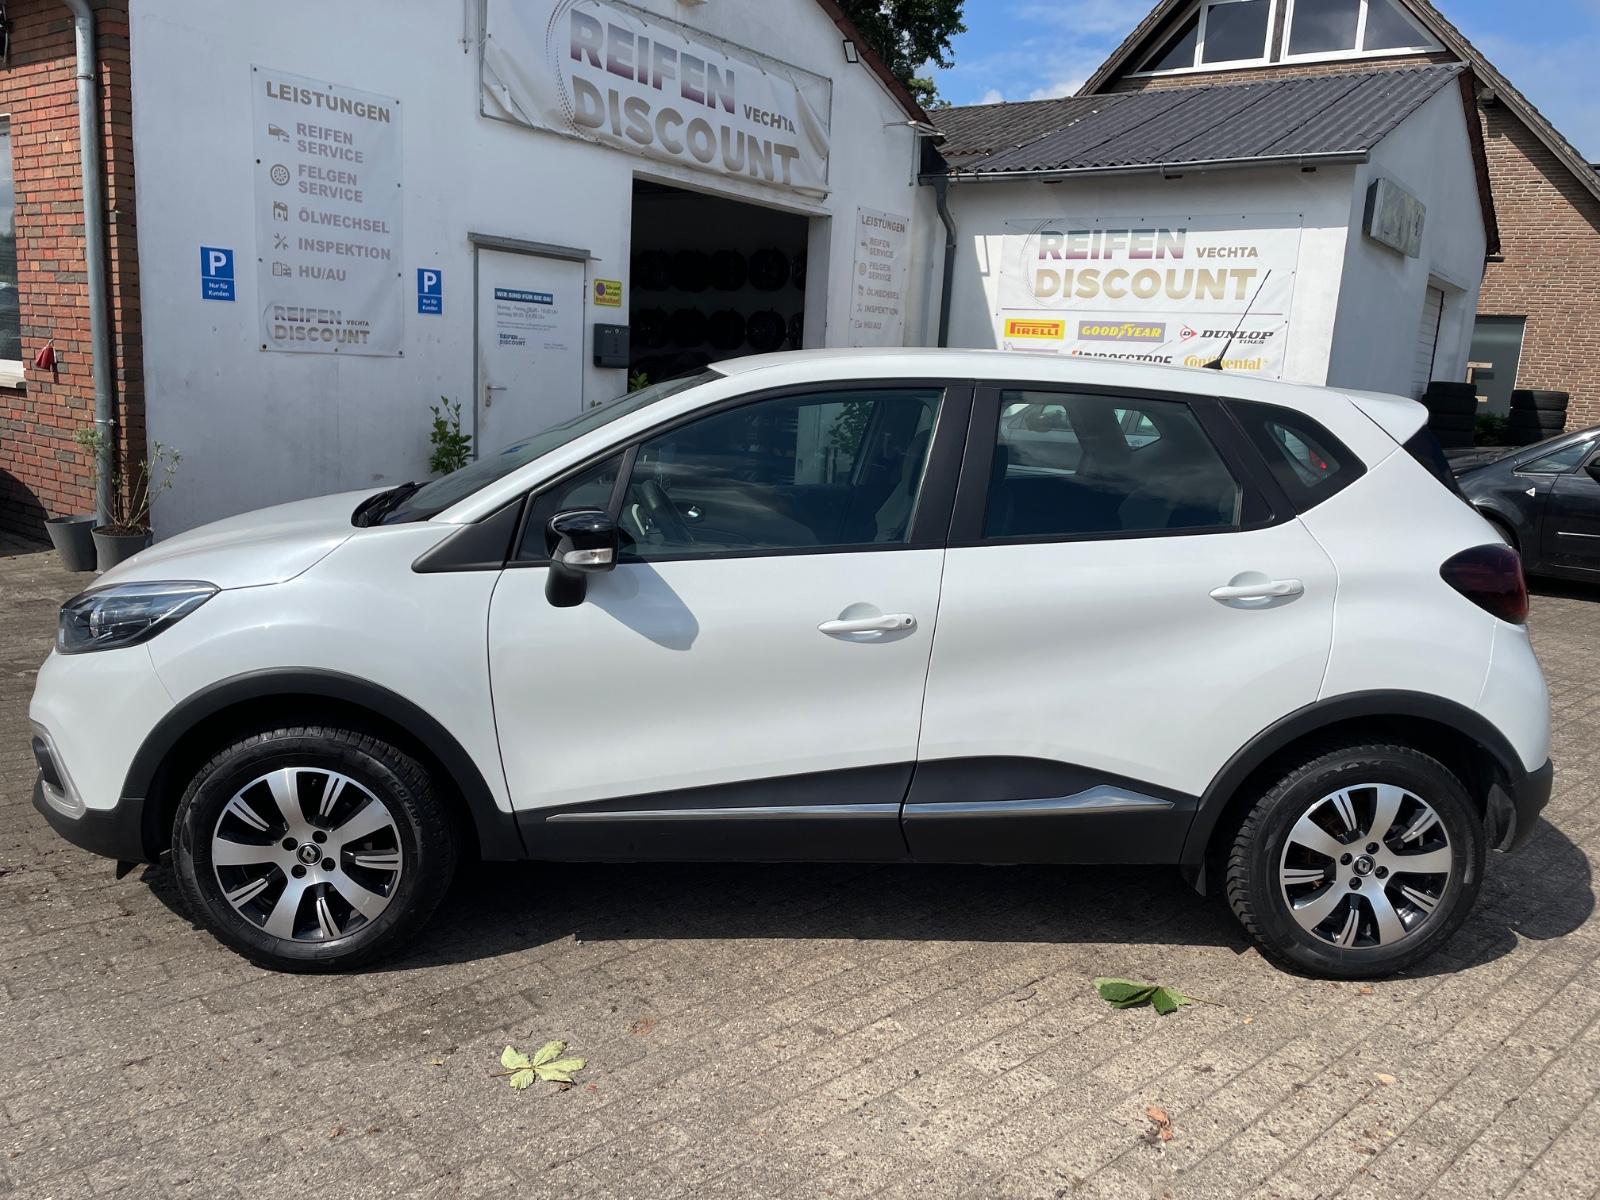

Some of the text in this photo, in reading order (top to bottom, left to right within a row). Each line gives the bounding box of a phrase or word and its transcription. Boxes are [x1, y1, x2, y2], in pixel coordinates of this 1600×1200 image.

[570, 8, 797, 135] REIFEN VECHTA
[266, 81, 391, 123] LEISTUNGEN
[296, 122, 353, 146] REIFEN
[571, 75, 800, 185] DISCOUNT
[297, 139, 364, 164] SERVICE
[297, 164, 357, 186] FELGEN
[298, 181, 364, 203] SERVICE
[298, 208, 391, 234] ÖLWECHSEL
[861, 214, 905, 233] LEISTUNGEN
[298, 237, 391, 260] INSPEKTION
[869, 236, 890, 248] REIFEN
[1038, 227, 1259, 260] REIFEN VECHTA
[209, 250, 227, 276] P
[869, 248, 894, 259] SERVICE
[298, 264, 347, 282] HU/AU
[868, 261, 891, 272] FELGEN
[868, 272, 892, 282] SERVICE
[423, 271, 437, 293] P
[1033, 267, 1258, 301] DISCOUNT
[273, 305, 370, 327] REIFEN VECHTA
[864, 304, 899, 316] INSPEKTION
[274, 324, 370, 344] DISCOUNT
[1010, 321, 1060, 336] PIRELLI
[1081, 324, 1162, 339] GOODYEAR
[1200, 329, 1274, 340] DUNLOP
[1183, 355, 1261, 370] Connental
